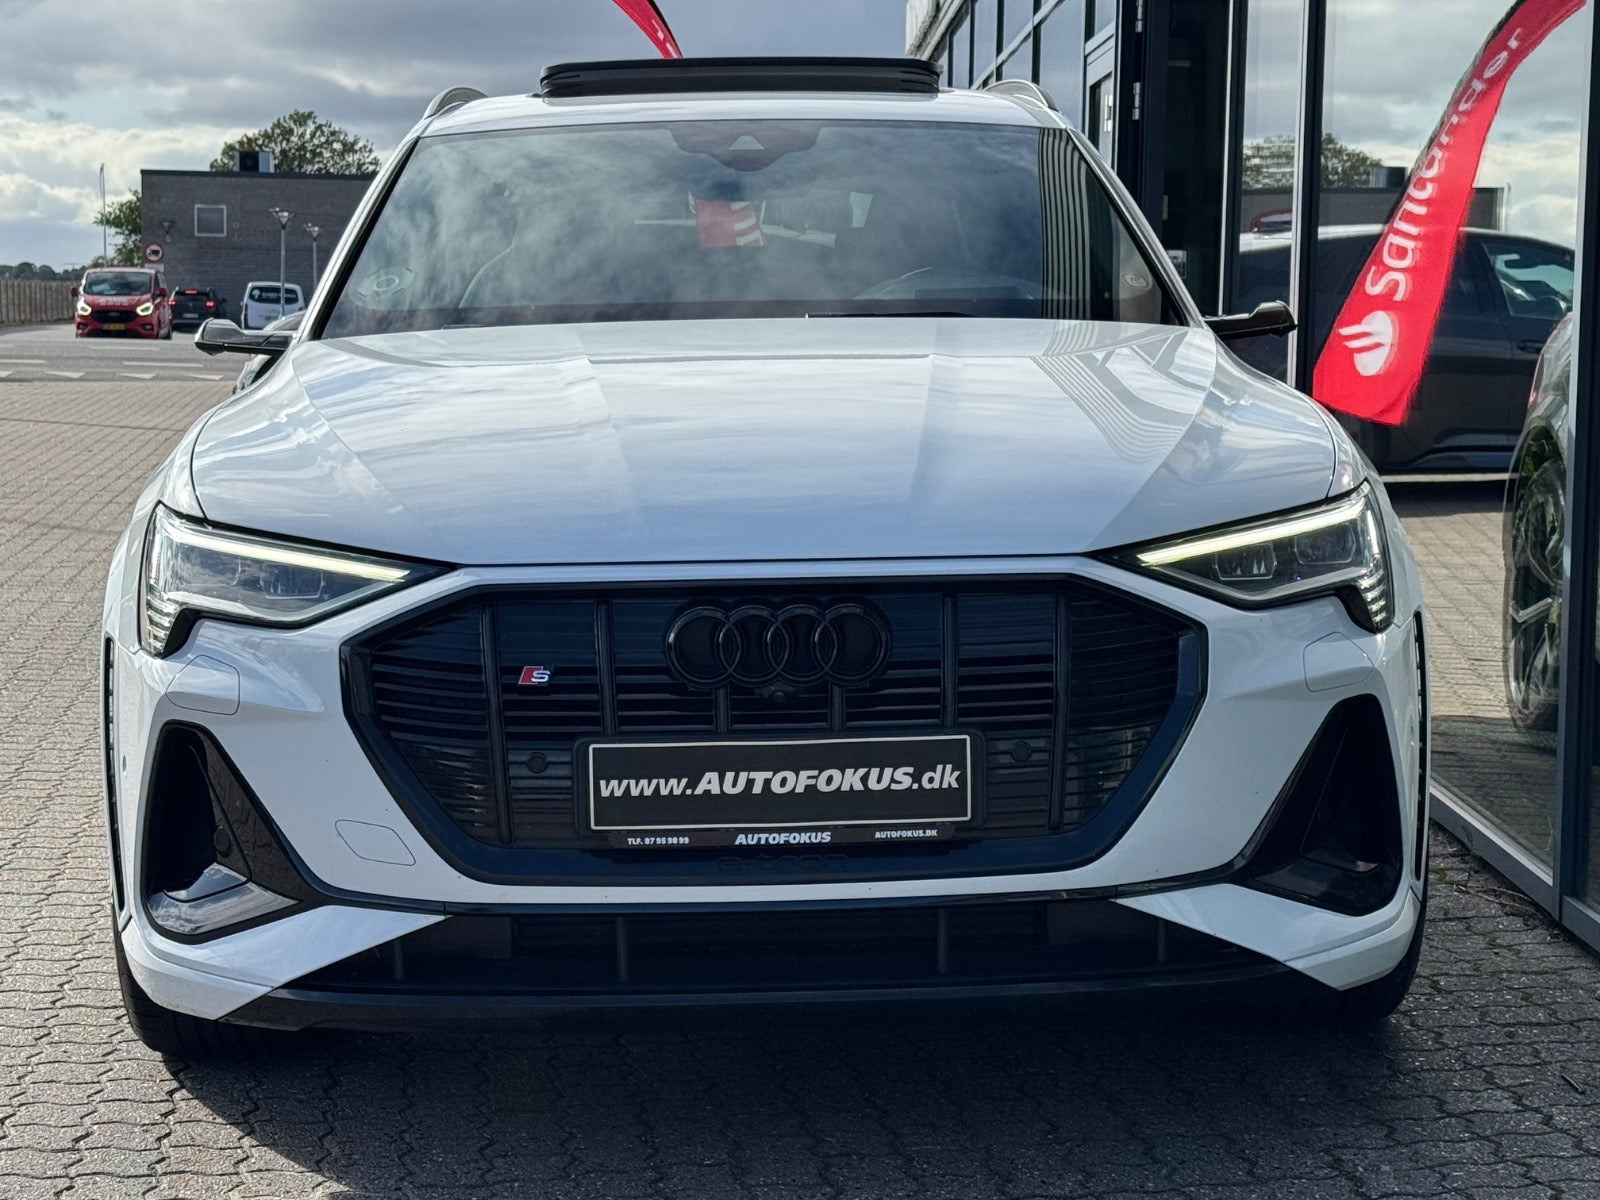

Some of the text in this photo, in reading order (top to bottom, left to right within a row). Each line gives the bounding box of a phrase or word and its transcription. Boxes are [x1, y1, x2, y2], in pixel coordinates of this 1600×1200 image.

[599, 764, 961, 797] www.AUTOFOKUS.dk
[734, 831, 832, 845] AUTOFOKUS
[874, 829, 938, 839] AUTOFOKUS.DK
